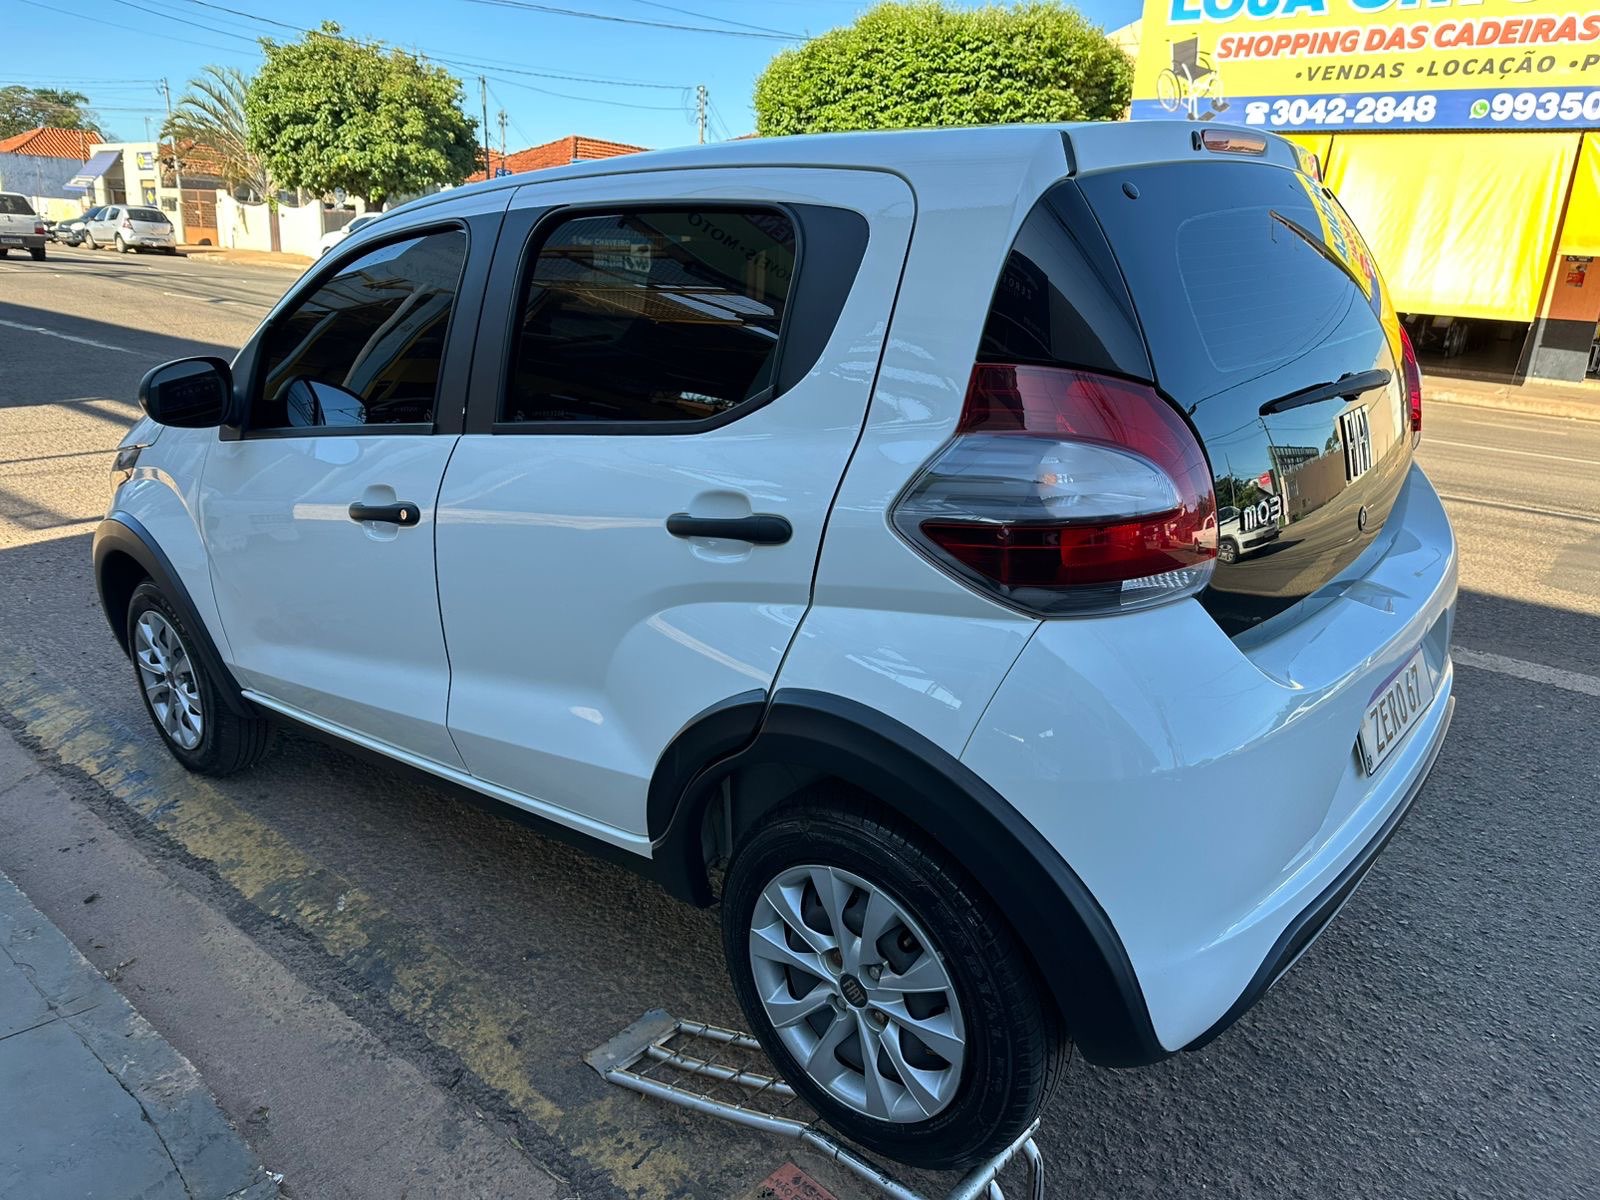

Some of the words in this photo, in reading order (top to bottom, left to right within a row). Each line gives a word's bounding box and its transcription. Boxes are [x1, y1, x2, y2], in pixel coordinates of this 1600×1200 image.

[1217, 29, 1360, 59] SHOPPING
[1364, 25, 1428, 51] DAS
[1434, 15, 1600, 48] CADEIRAS
[1427, 51, 1556, 80] LOCAÇÃO
[1270, 95, 1437, 126] 3042-2848
[1370, 681, 1408, 754] ZERO
